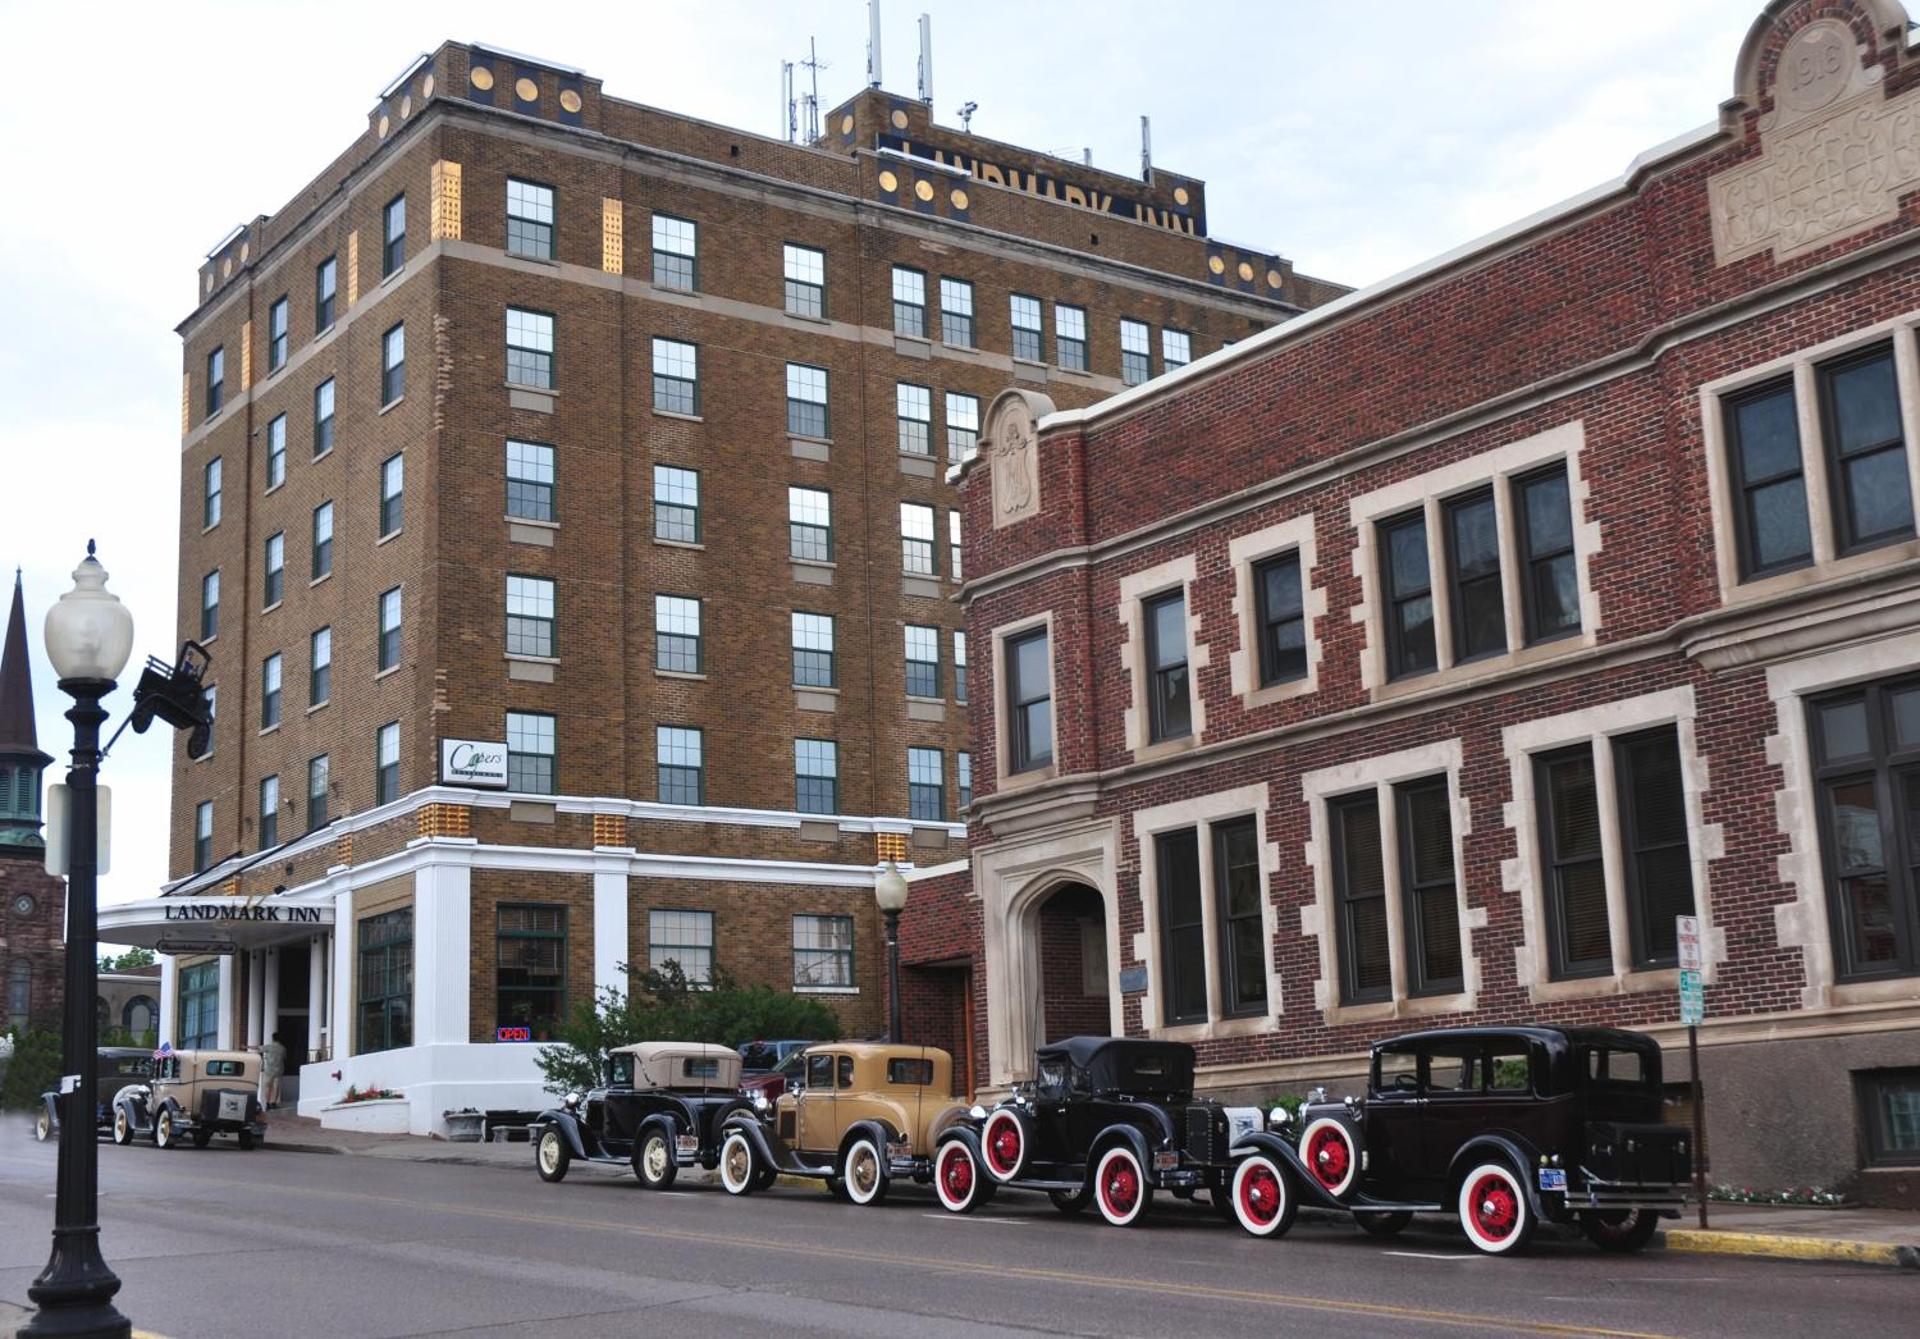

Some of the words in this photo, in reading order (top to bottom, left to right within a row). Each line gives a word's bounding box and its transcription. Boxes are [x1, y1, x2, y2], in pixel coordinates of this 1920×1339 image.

[165, 905, 279, 921] LANDMARK
[287, 906, 321, 922] INN
[498, 1027, 528, 1041] OPEN
